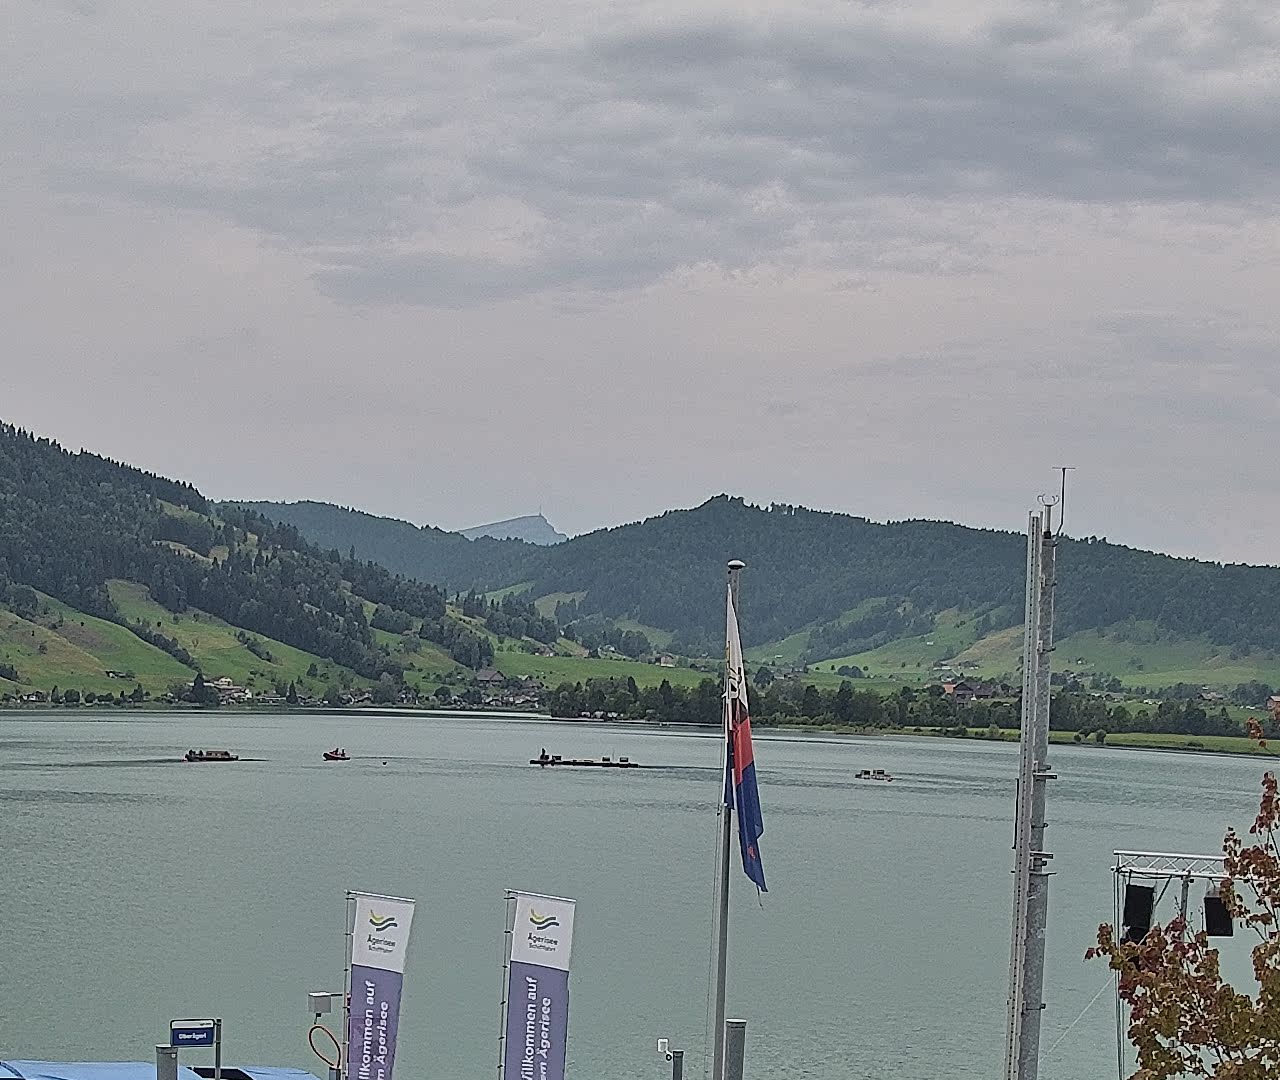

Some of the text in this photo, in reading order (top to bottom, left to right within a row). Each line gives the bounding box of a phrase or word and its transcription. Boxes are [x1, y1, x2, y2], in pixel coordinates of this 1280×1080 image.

[365, 980, 376, 1005] auf
[526, 976, 538, 1001] auf
[373, 1001, 389, 1064] Ägerisee
[536, 997, 552, 1058] Ägerisee
